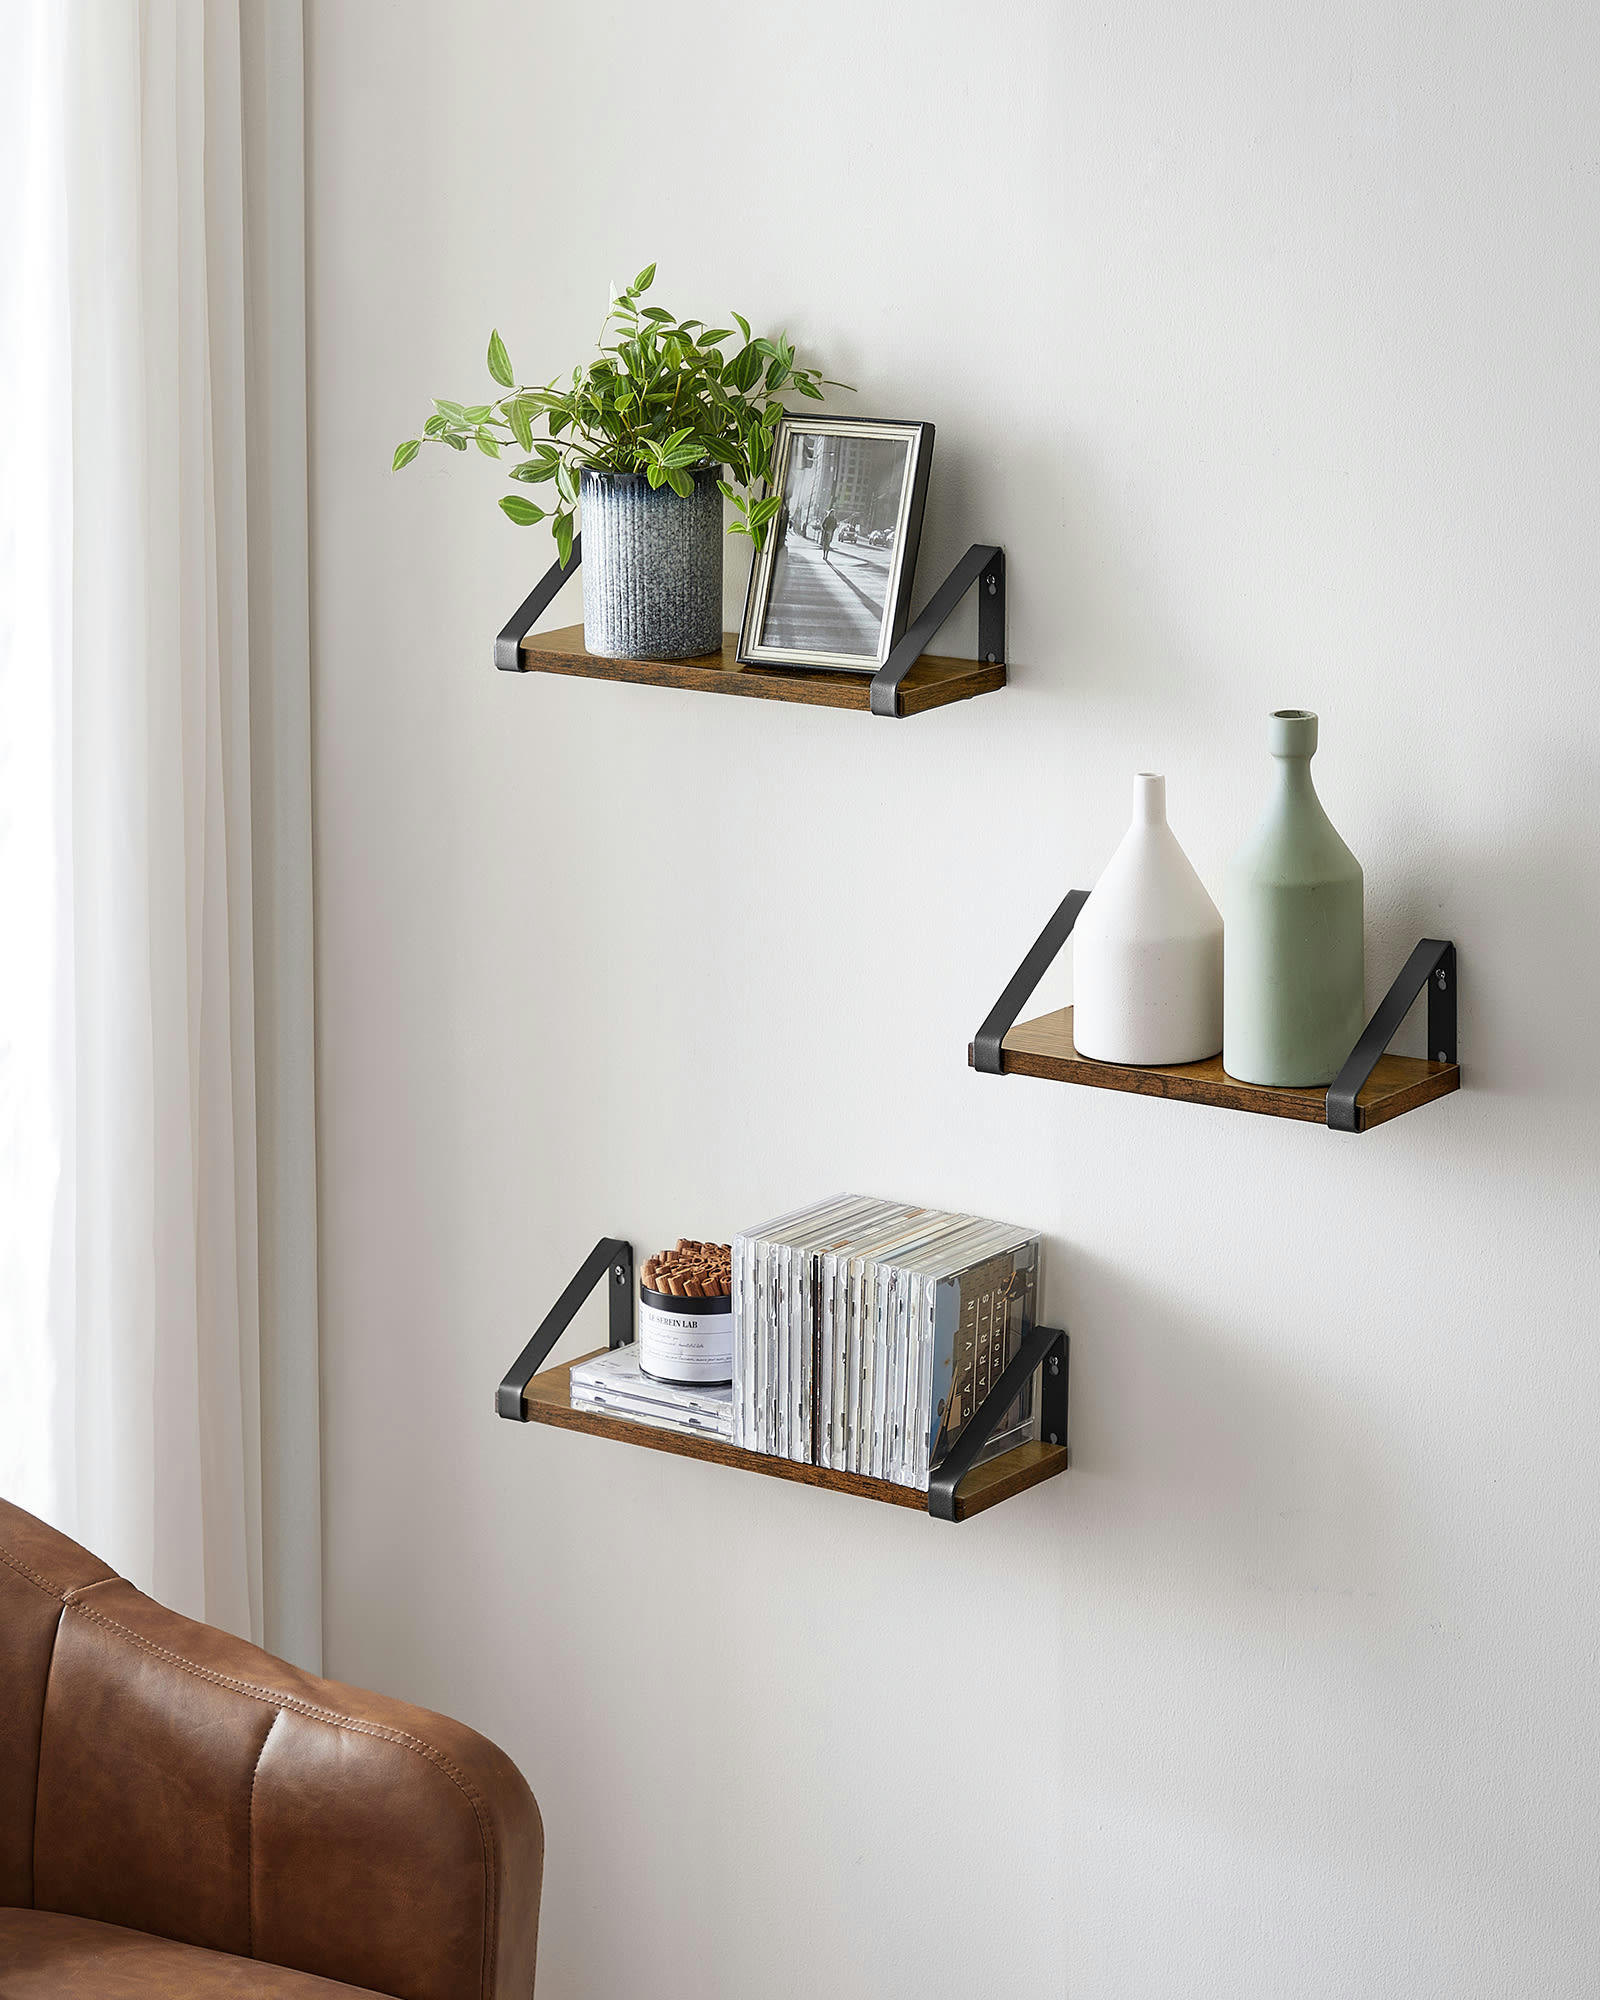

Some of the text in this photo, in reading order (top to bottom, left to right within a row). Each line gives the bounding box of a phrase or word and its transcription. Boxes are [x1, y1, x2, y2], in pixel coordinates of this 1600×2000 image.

[657, 1317, 681, 1328] EREIN
[682, 1320, 698, 1328] LAB
[963, 1300, 975, 1417] CALVIN
